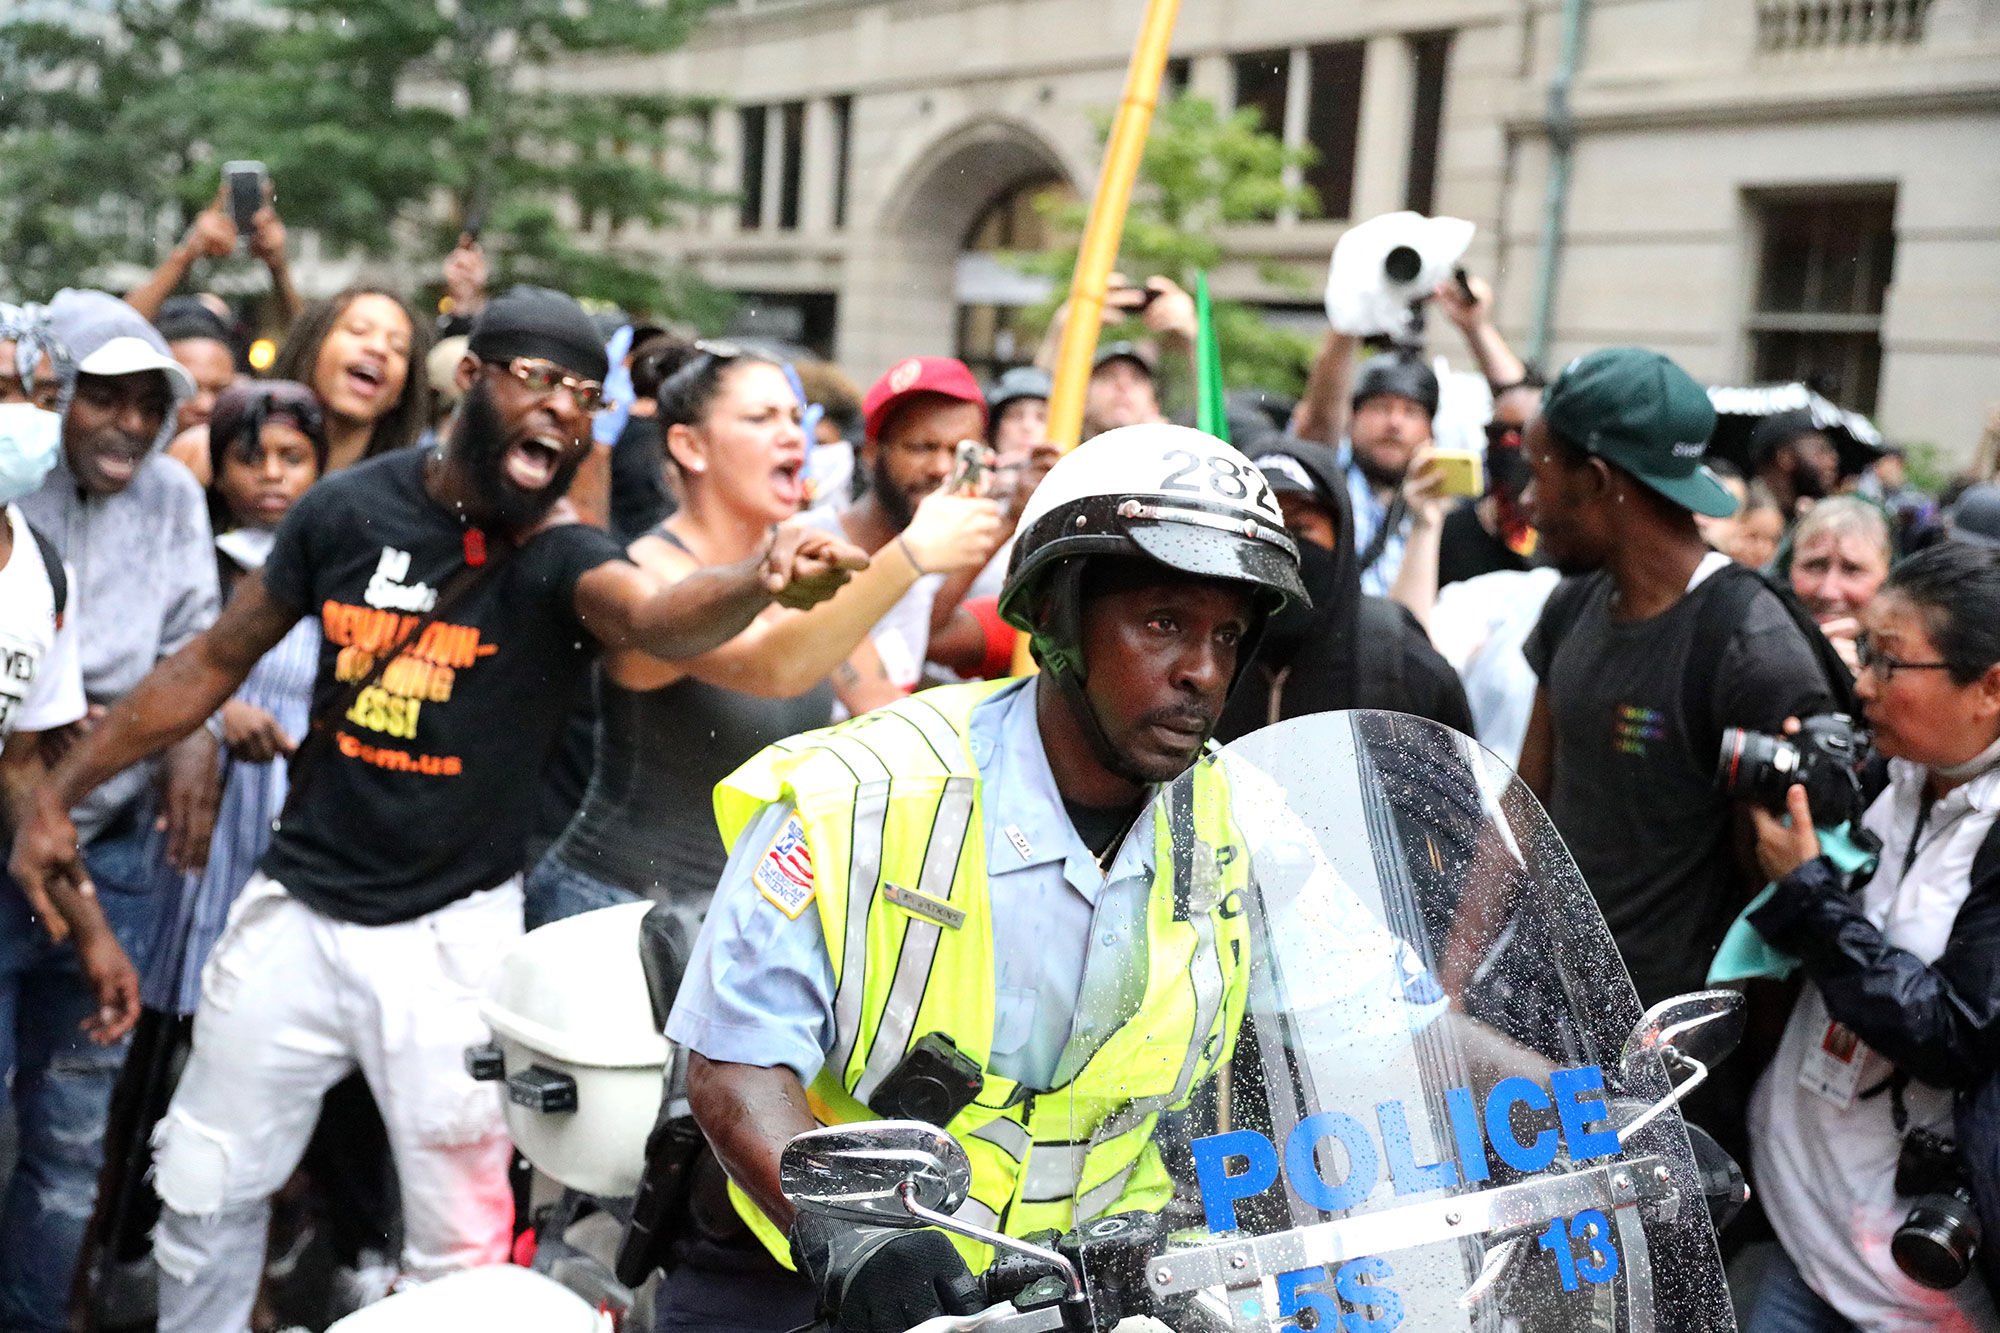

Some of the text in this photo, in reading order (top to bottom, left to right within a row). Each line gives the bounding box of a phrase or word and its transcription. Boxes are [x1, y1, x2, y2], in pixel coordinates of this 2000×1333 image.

[1159, 450, 1277, 517] 282
[1191, 1065, 1622, 1234] POLICE
[1277, 1256, 1405, 1333] 5S
[1538, 1209, 1618, 1292] 13
